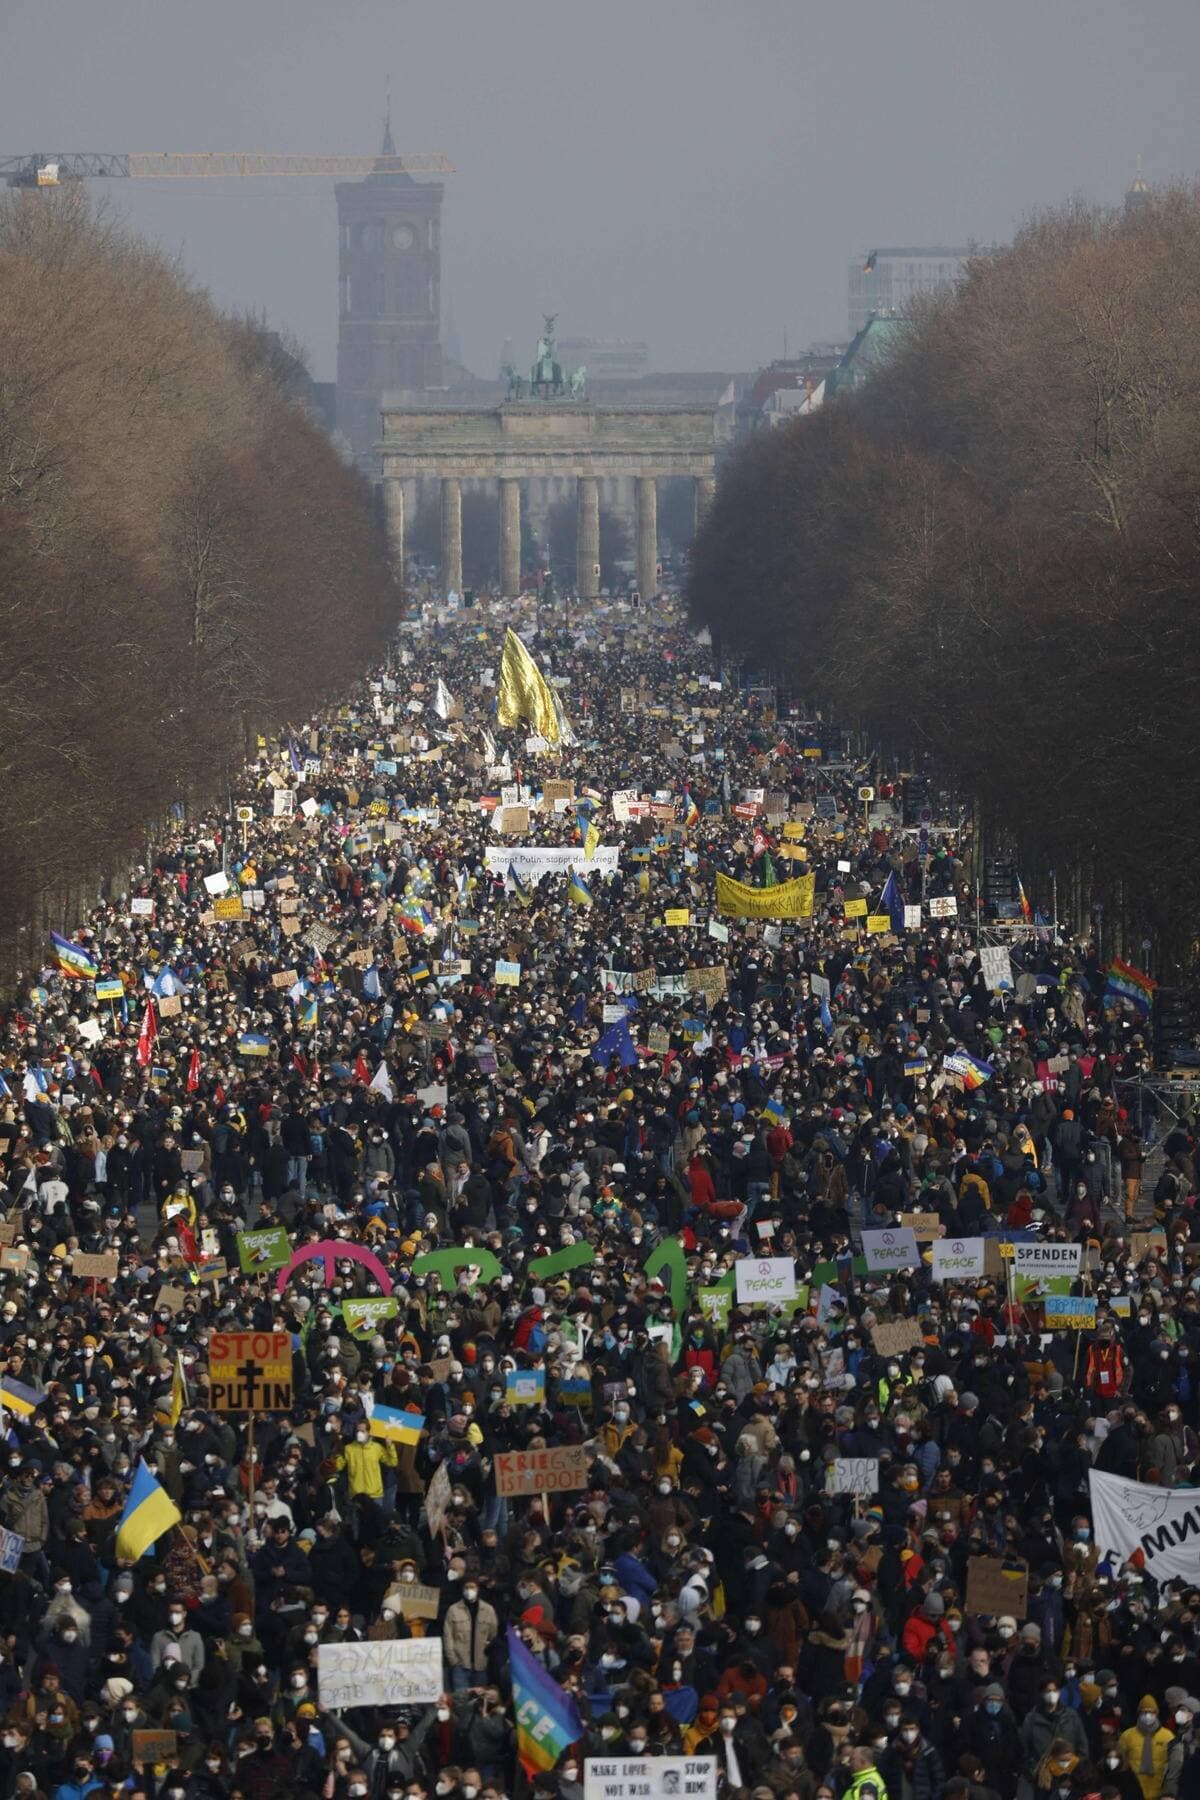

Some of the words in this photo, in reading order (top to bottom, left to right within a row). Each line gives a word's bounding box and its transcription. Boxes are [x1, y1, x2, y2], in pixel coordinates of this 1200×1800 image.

[305, 759, 321, 767] FCK
[491, 855, 518, 864] Stoppt
[520, 855, 542, 864] Putin,
[546, 856, 571, 864] stoppt
[765, 895, 810, 912] UKRAINE
[981, 947, 1008, 961] STOP
[983, 961, 1010, 976] THIS
[242, 1232, 281, 1248] PEACE
[872, 1246, 909, 1260] PEACE
[1017, 1248, 1078, 1260] SPENDEN
[938, 1256, 978, 1269] PEACE
[744, 1276, 786, 1291] PEACE
[702, 1293, 728, 1307] PEACE
[348, 1302, 391, 1317] PEACE
[210, 1334, 289, 1360] STOP
[210, 1364, 237, 1378] WAR
[264, 1363, 290, 1378] GAS
[211, 1383, 291, 1408] PUTIN
[499, 1451, 566, 1475] KRIEG
[837, 1459, 876, 1477] STOP
[501, 1475, 526, 1492] IST
[535, 1470, 582, 1489] DOOF
[839, 1477, 873, 1498] WAR
[1141, 1503, 1200, 1560] МИ
[397, 1586, 433, 1601] PUTIN
[591, 1764, 617, 1776] MAKE
[684, 1762, 711, 1775] STOP
[604, 1783, 624, 1796] NOT
[628, 1783, 651, 1796] WAR
